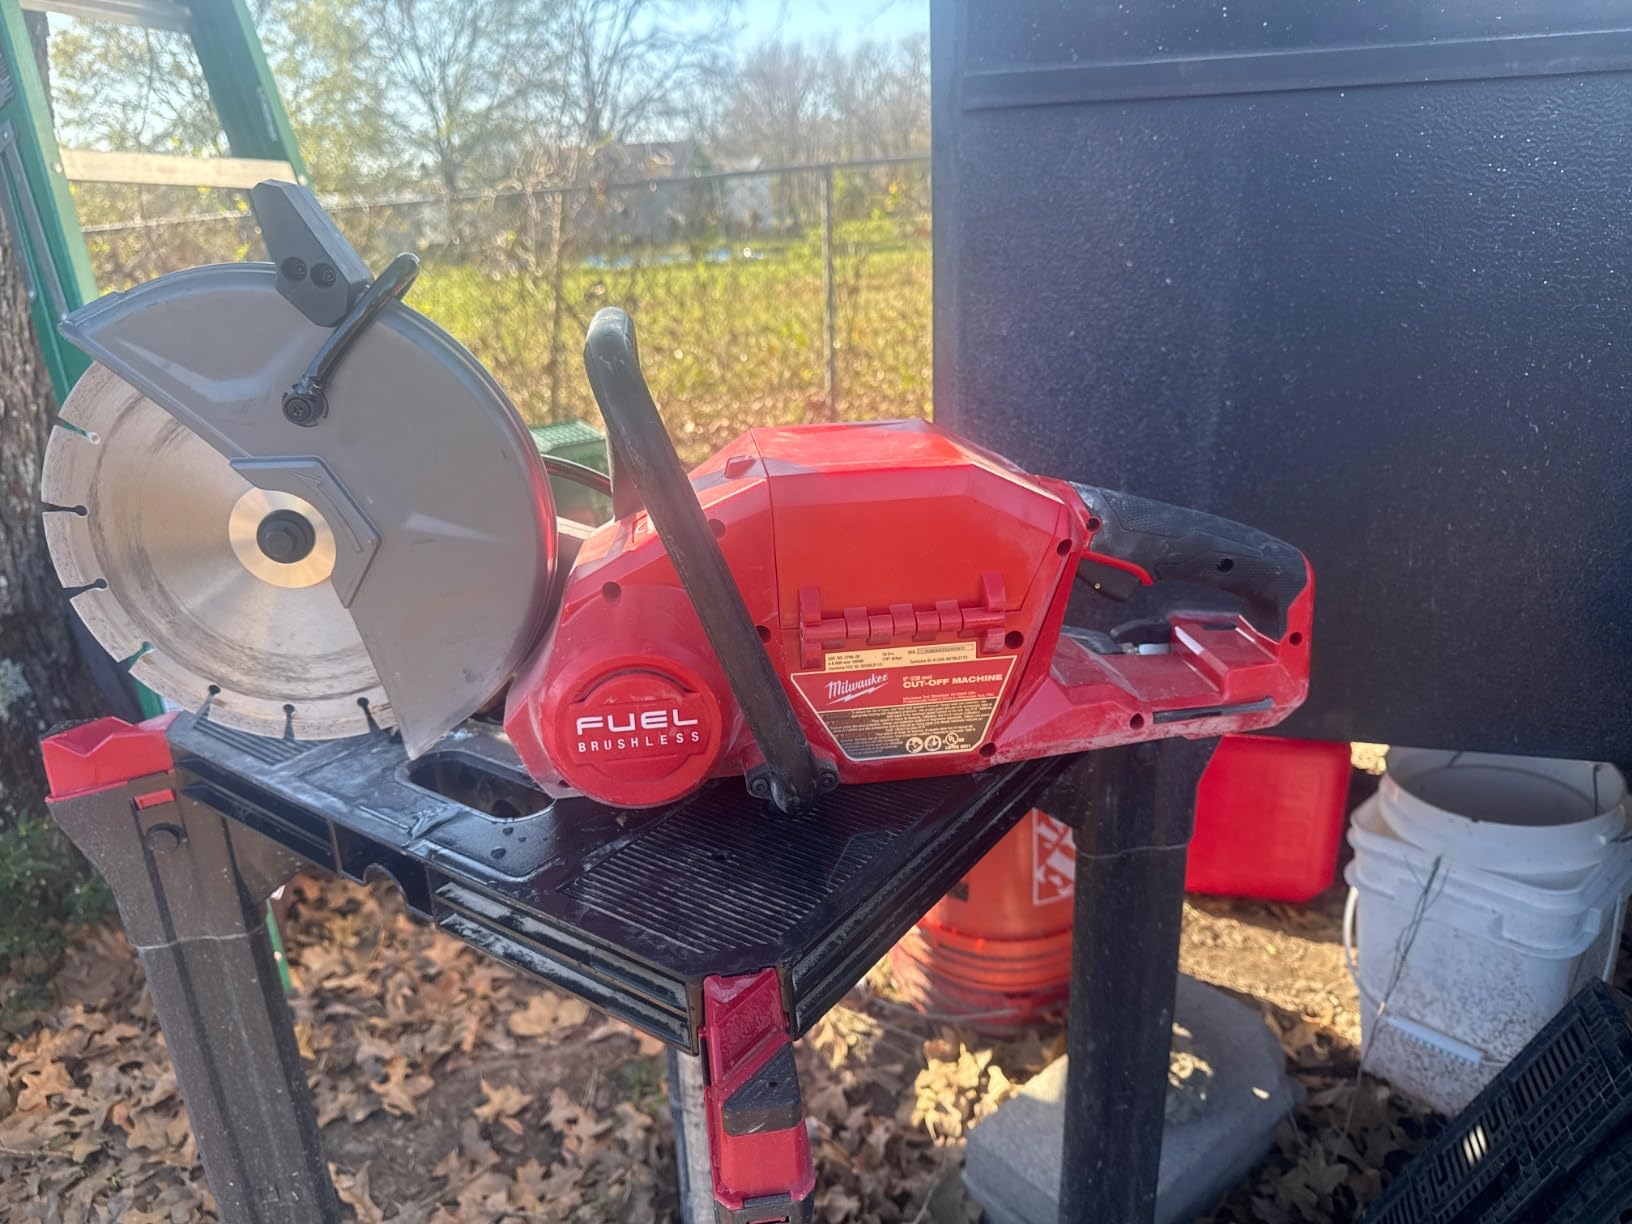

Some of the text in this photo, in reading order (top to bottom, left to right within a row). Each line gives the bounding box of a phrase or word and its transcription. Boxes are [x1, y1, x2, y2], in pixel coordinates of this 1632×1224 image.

[824, 673, 888, 699] Milwaukee
[903, 674, 1003, 688] CUT-OFF MACHINE
[576, 709, 698, 735] FUEL
[578, 731, 699, 752] BRUSHLESS
